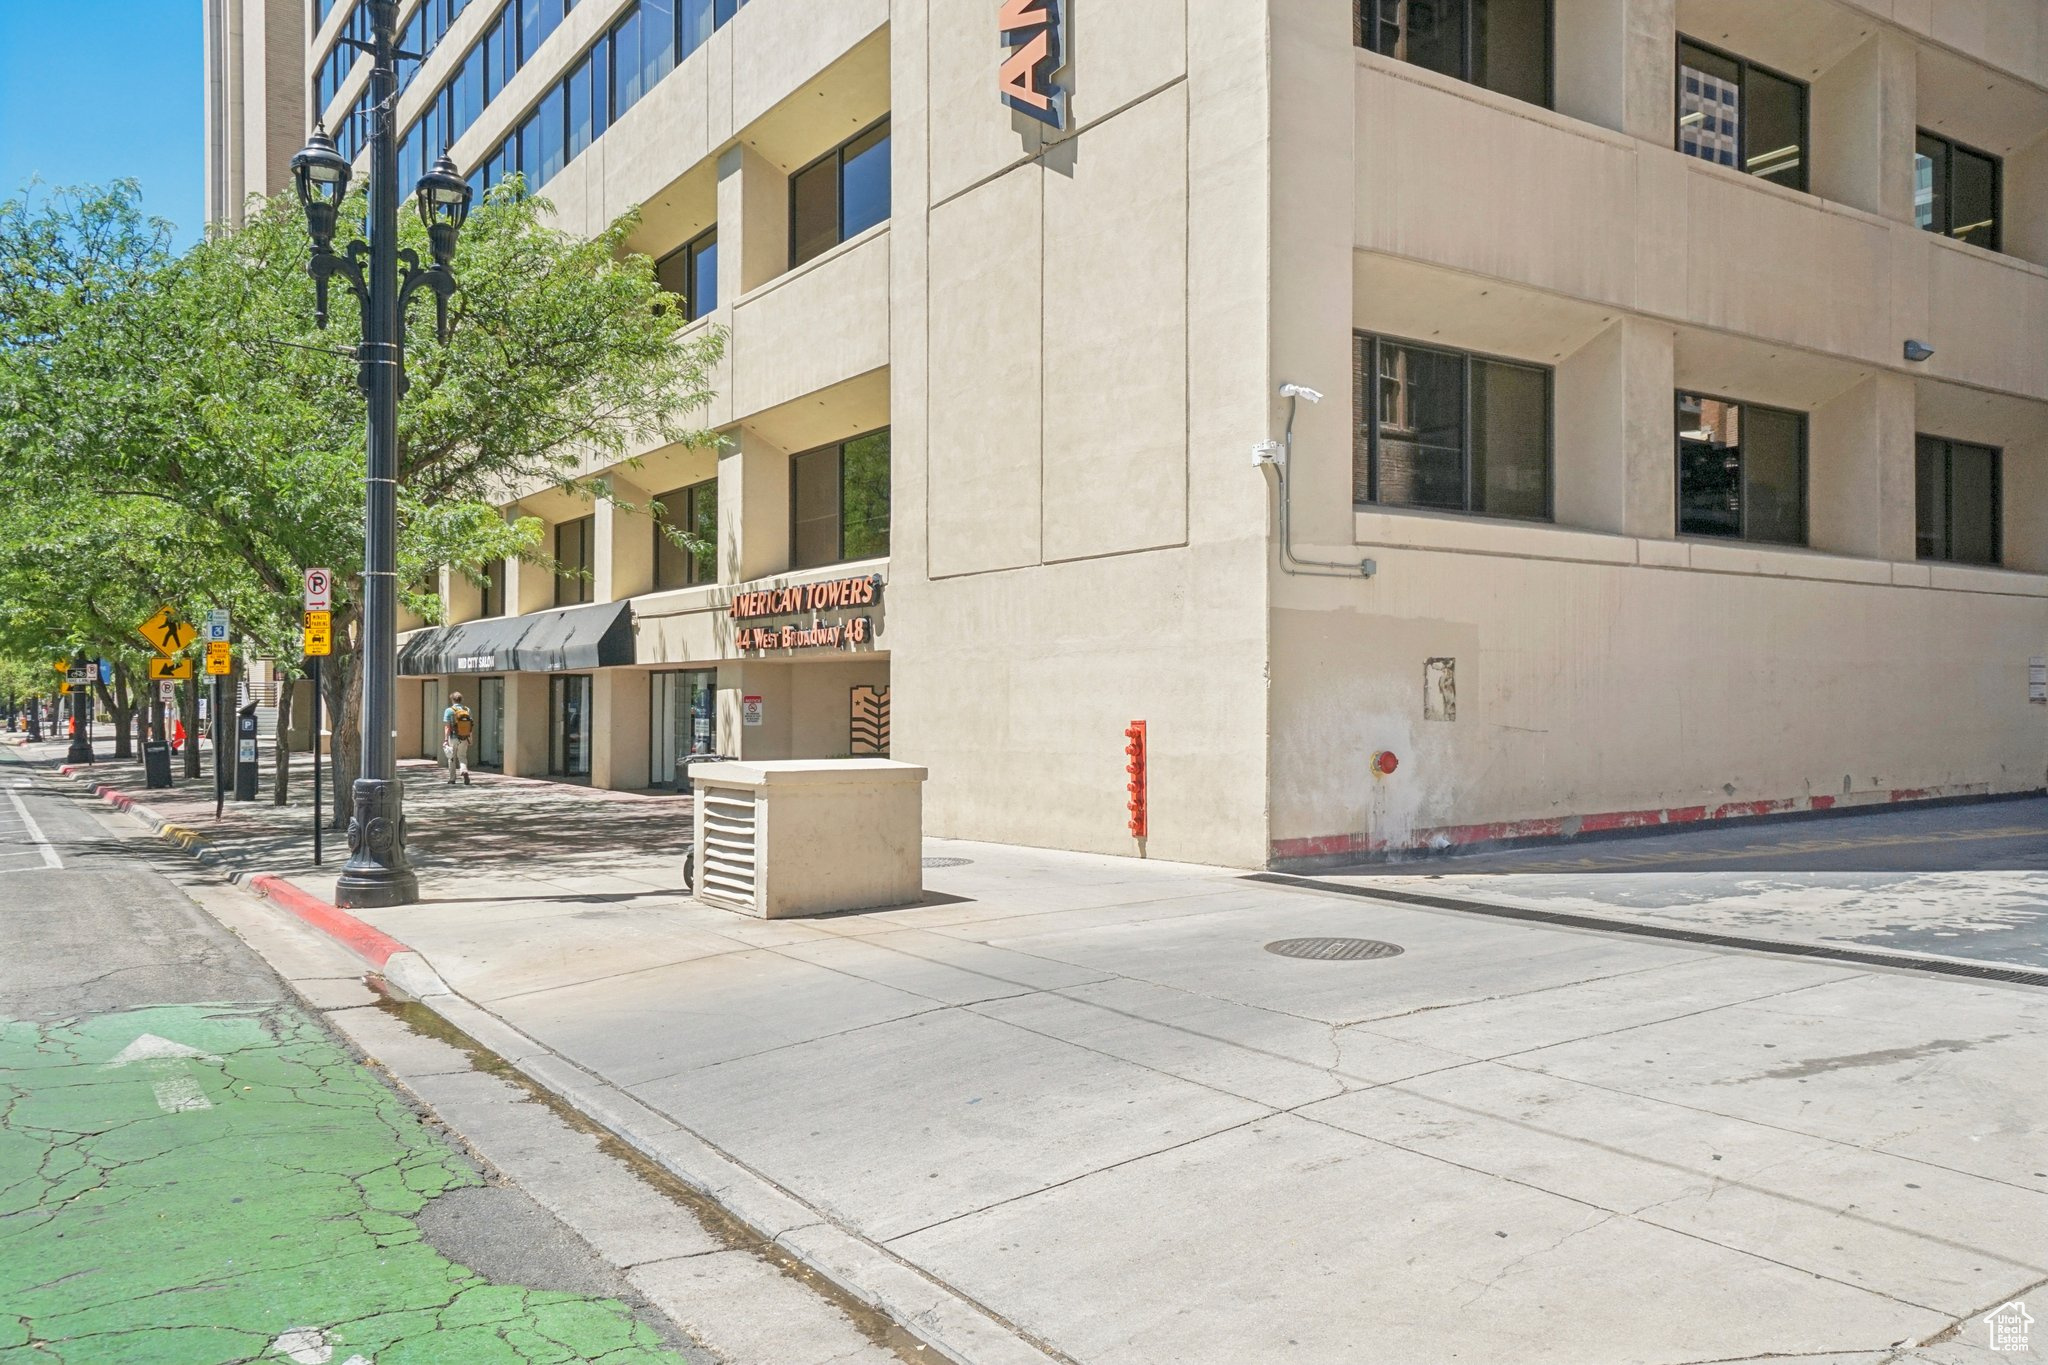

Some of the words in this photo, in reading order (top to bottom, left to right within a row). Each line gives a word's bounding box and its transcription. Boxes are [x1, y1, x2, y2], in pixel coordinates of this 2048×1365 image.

[730, 586, 803, 618] AMERICAN
[807, 575, 873, 609] TOWERS
[306, 614, 311, 627] 3
[736, 627, 750, 649] 44
[844, 618, 863, 641] 48
[208, 643, 212, 653] 3
[468, 656, 478, 668] CITY
[478, 656, 494, 668] SALON
[244, 720, 252, 729] P
